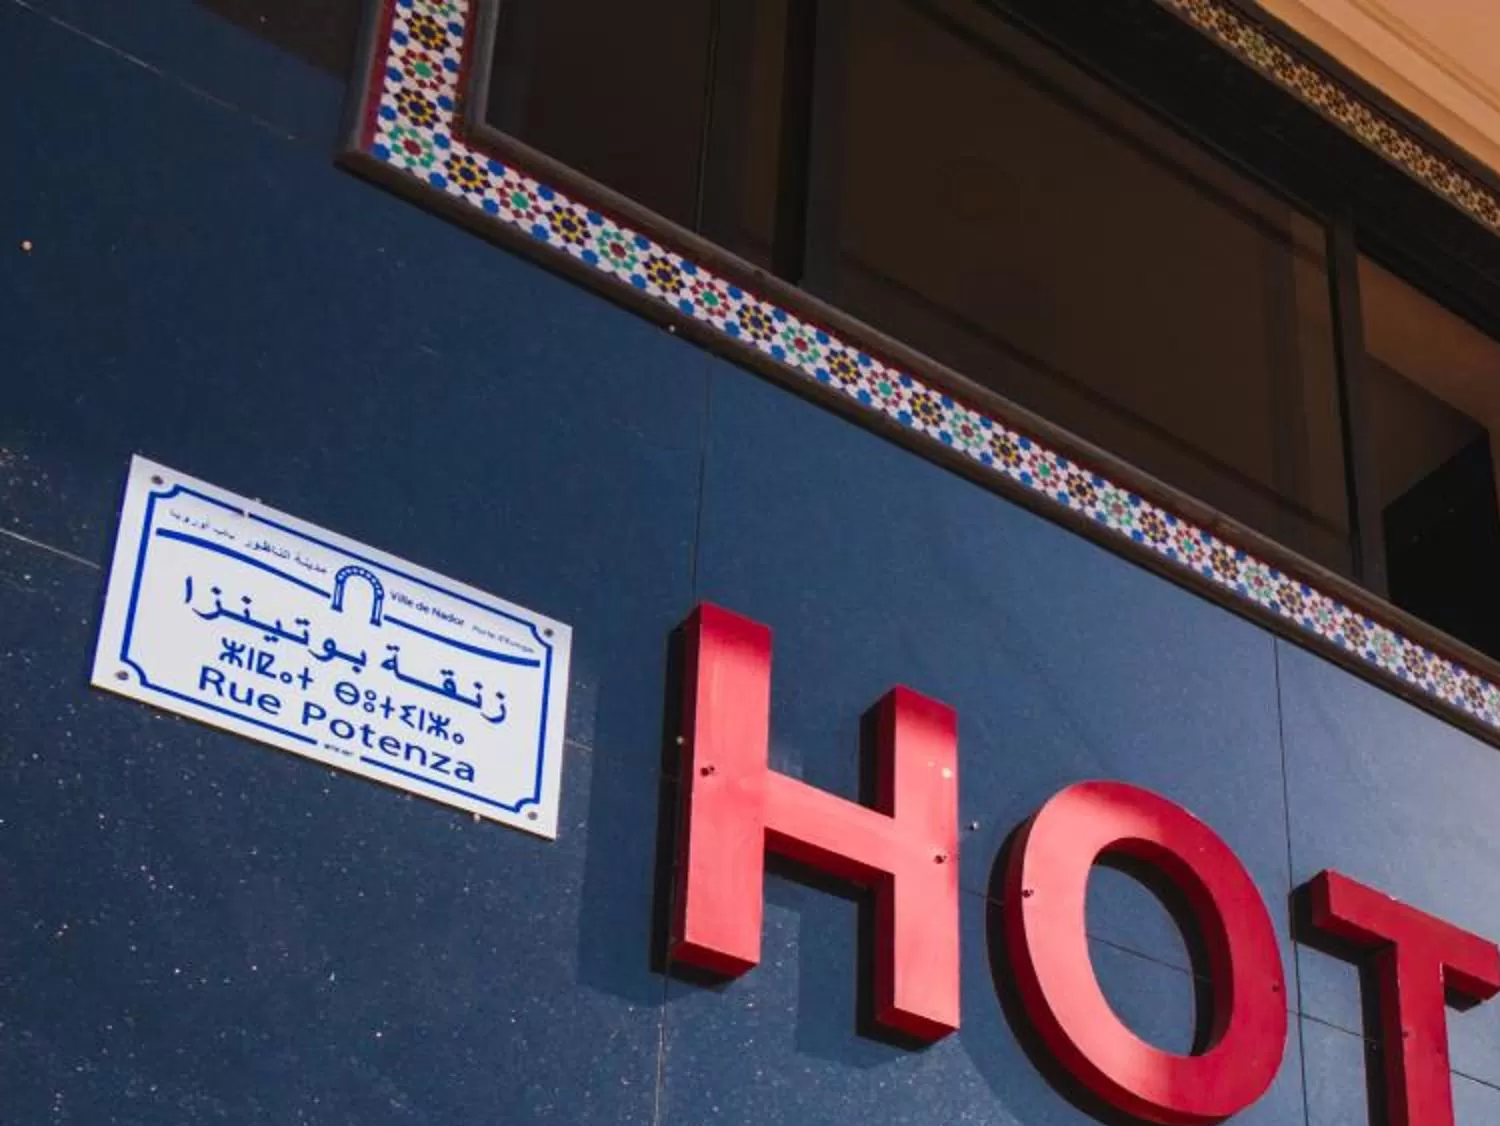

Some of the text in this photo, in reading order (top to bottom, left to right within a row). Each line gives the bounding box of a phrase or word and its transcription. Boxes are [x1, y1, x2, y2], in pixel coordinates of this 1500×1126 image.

[184, 576, 506, 724] زنقة بوتينزا
[389, 591, 464, 626] Ville de Nador
[198, 665, 476, 783] Rue Potenza
